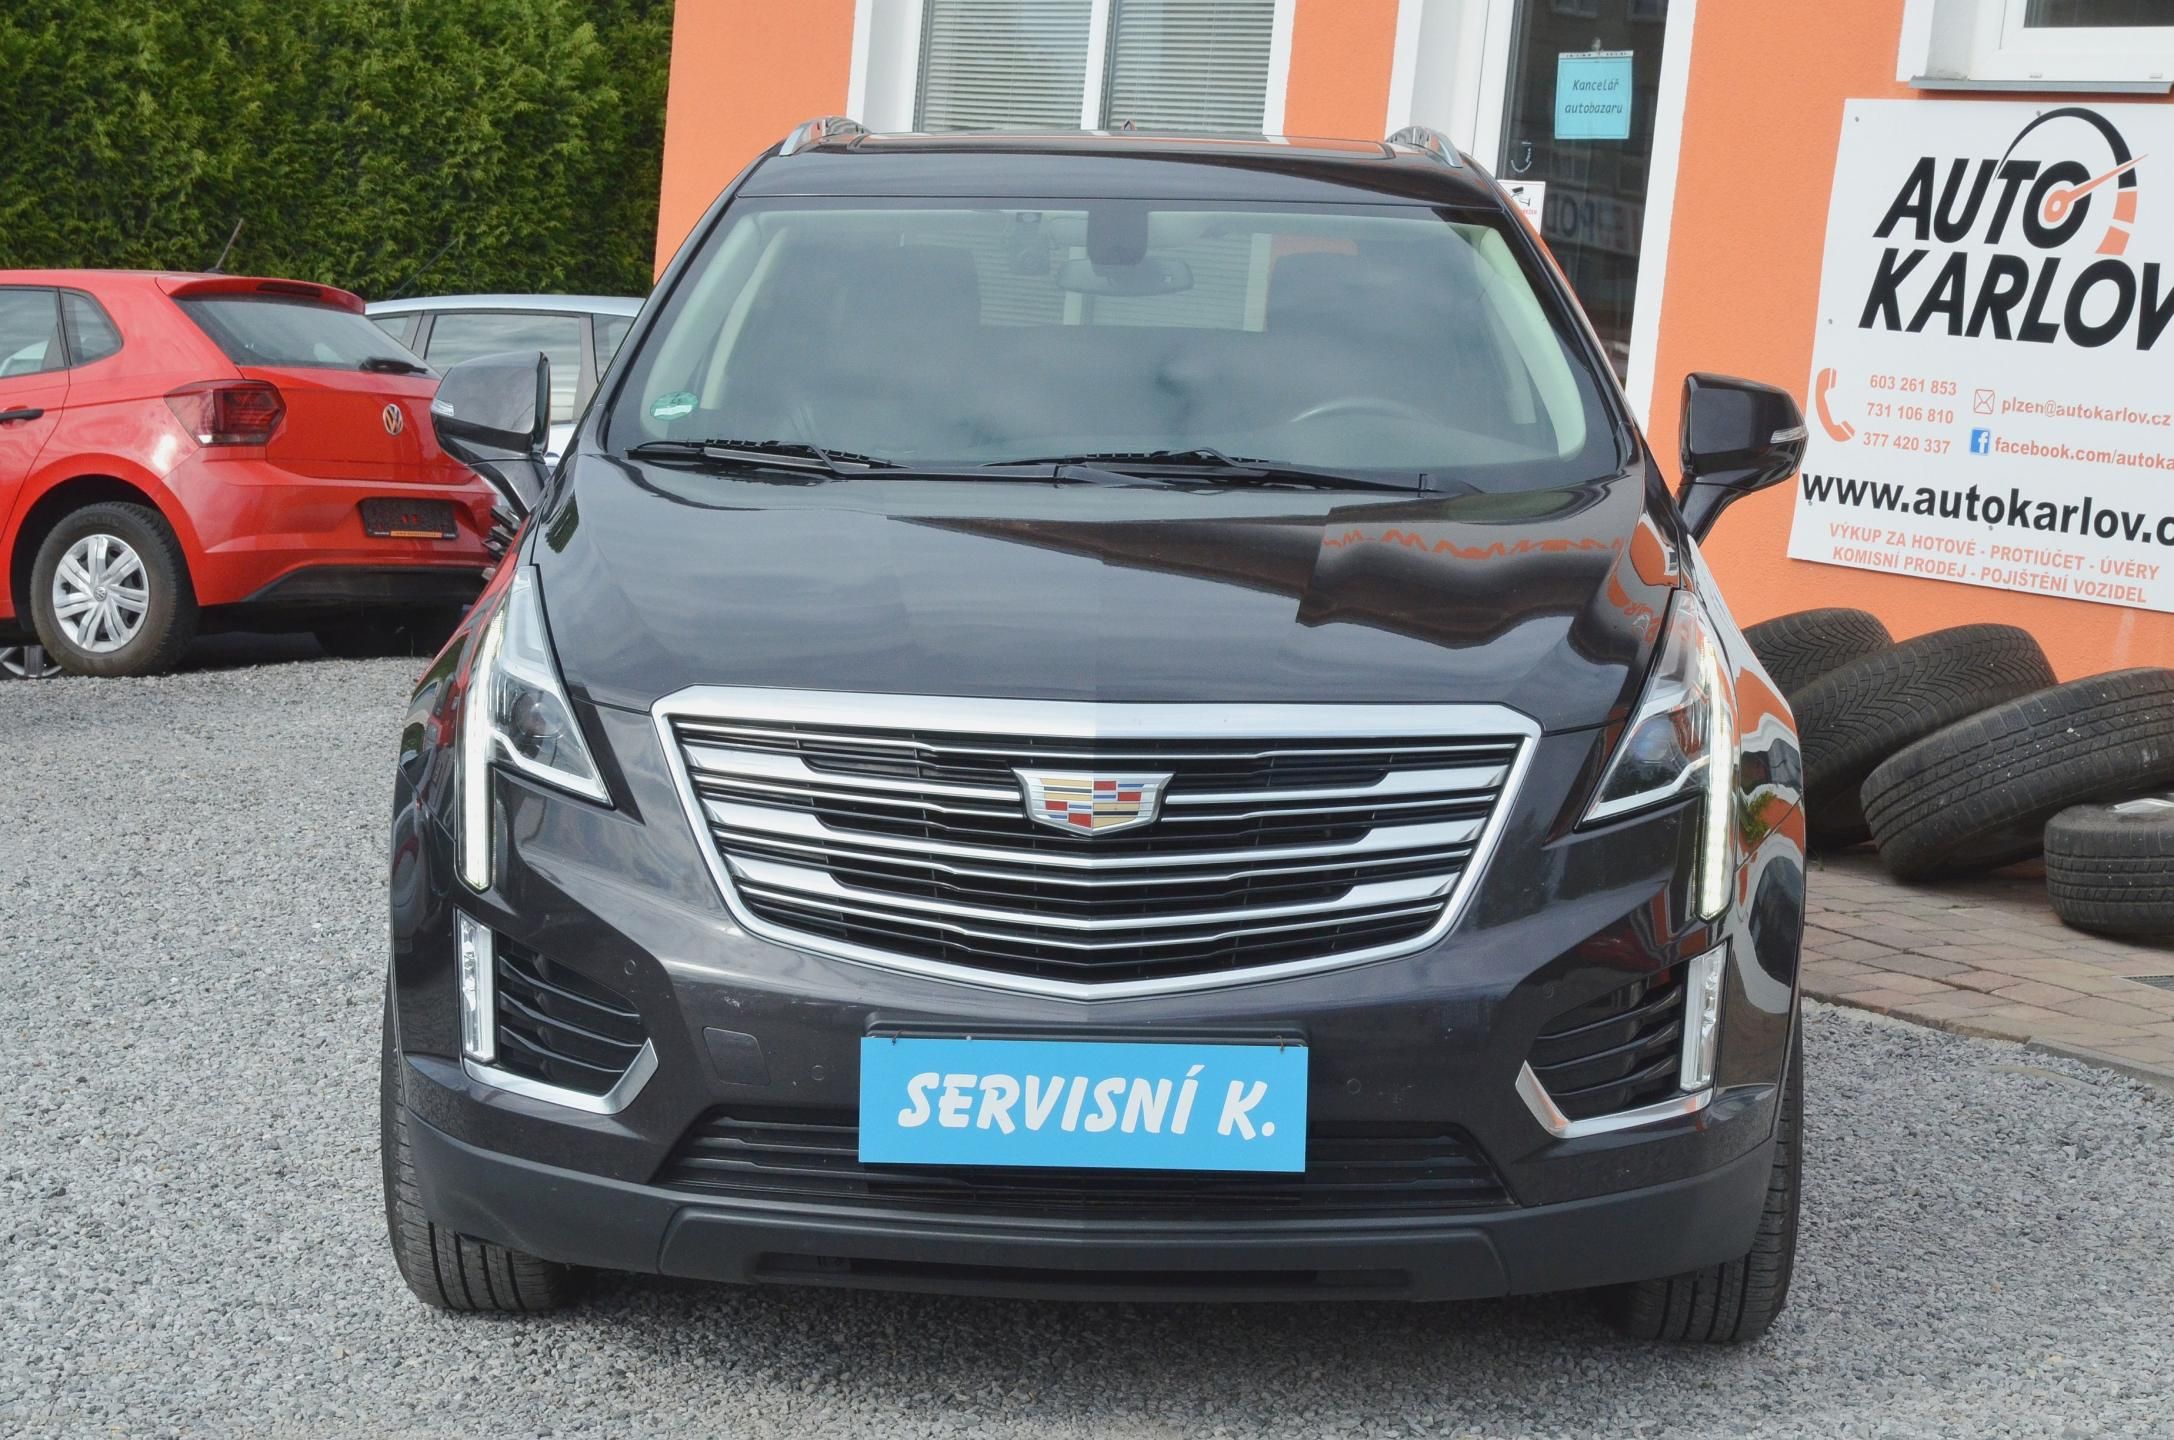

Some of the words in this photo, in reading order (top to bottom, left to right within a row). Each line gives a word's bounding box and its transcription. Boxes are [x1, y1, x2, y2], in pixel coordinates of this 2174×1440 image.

[1572, 79, 1619, 91] Kancelář
[1565, 101, 1623, 114] autobazaru
[1872, 157, 2092, 249] AUTO
[1870, 374, 1896, 390] 603
[1900, 377, 1925, 392] 261
[1930, 380, 1957, 396] 853
[1867, 402, 1891, 417] 731
[1897, 405, 1923, 421] 106
[1927, 408, 1954, 424] 810
[2001, 396, 2172, 426] plzen@autokarlov.cz
[1863, 432, 1889, 447] 377
[1893, 435, 1920, 451] 420
[1924, 438, 1951, 454] 337
[1829, 521, 1882, 543] VÝKUP
[1886, 530, 1906, 547] ZA
[1911, 534, 1977, 556] HOTOVÉ
[2100, 555, 2160, 580] ÚVĚRY
[1832, 546, 1900, 568] KOMISNÍ
[1904, 556, 1968, 578] PRODEJ
[2074, 579, 2147, 603] VOZIDEL
[897, 1064, 1206, 1136] SERVISNÍ
[1217, 1080, 1275, 1141] K.
